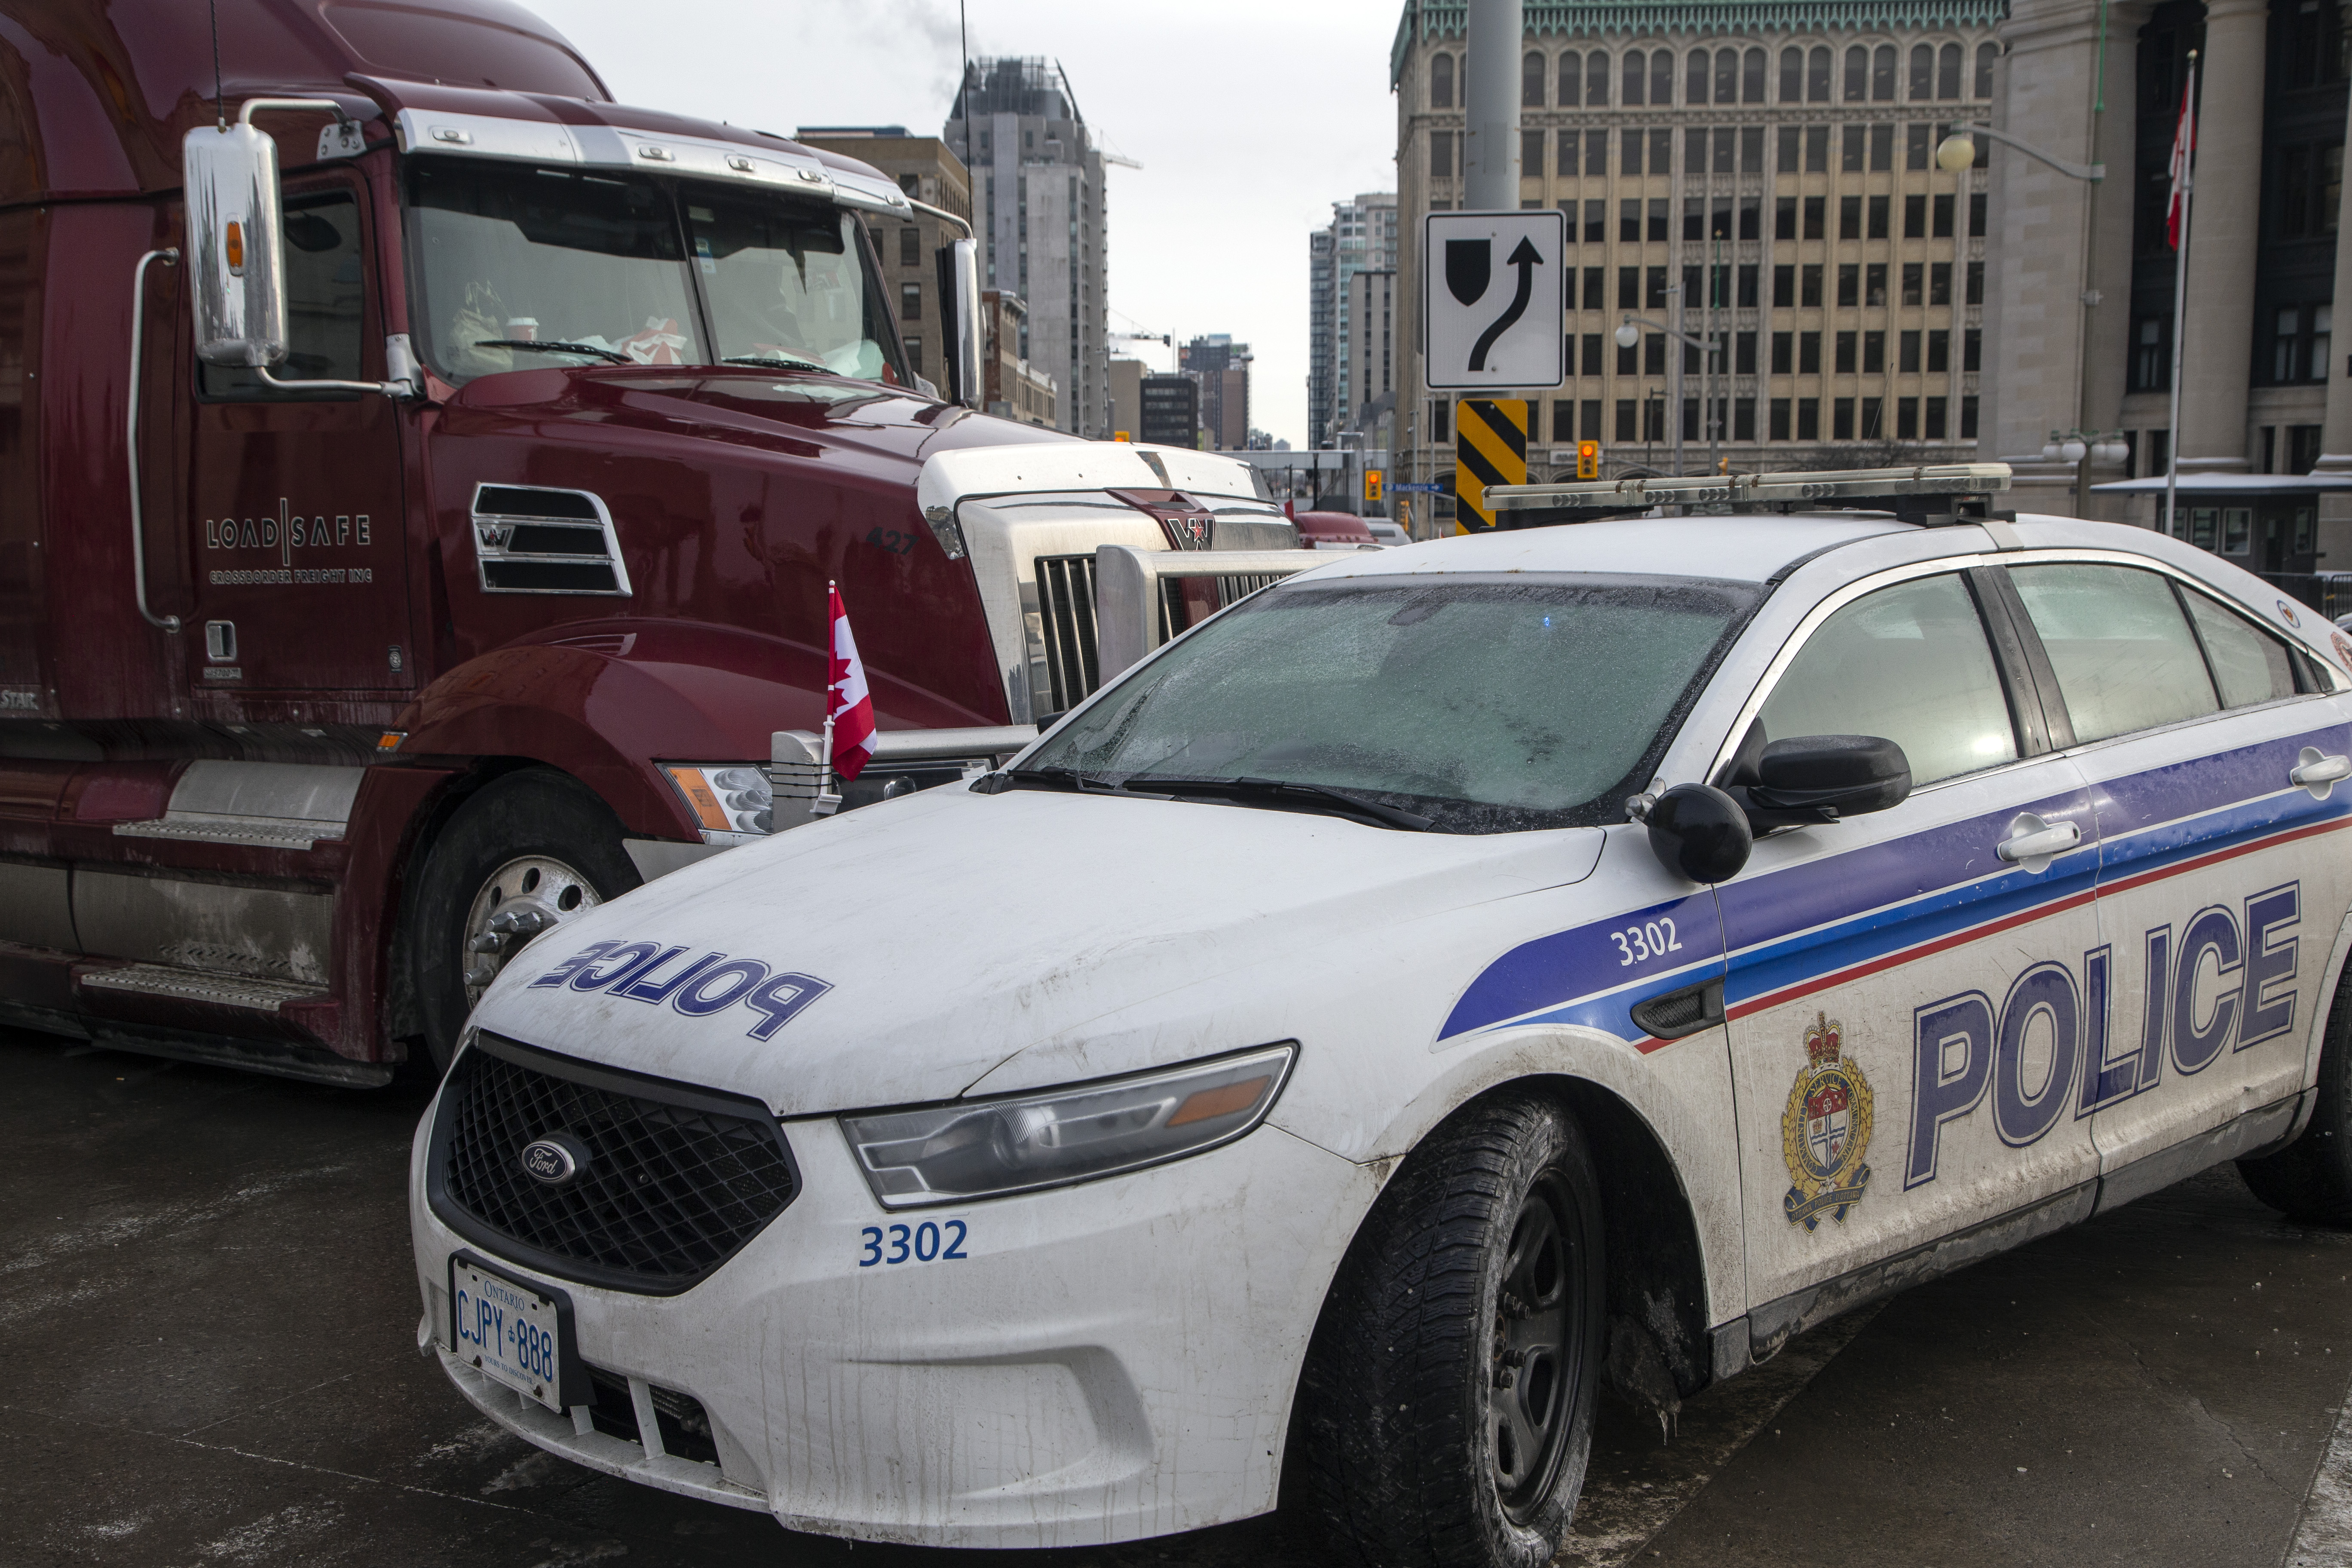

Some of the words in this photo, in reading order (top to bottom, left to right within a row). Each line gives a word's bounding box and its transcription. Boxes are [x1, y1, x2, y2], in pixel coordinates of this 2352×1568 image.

[866, 527, 920, 555] 427
[209, 570, 293, 585] CROSSBORDER
[294, 569, 345, 583] FREIGHT
[349, 568, 373, 583] INC
[0, 689, 39, 710] STAR
[1611, 917, 1682, 966] 3302
[1904, 879, 2300, 1192] POLICE
[1810, 1073, 1843, 1095] SERVICE
[1798, 1100, 1818, 1174] COMMUNITY
[530, 1148, 558, 1175] Ford
[1792, 1204, 1812, 1221] OTTAWA
[1814, 1194, 1833, 1208] POLICE
[1835, 1190, 1860, 1201] D'OTTAWA
[860, 1219, 968, 1267] 3302
[484, 1280, 525, 1311] ONTARIO
[458, 1289, 503, 1357] CJPY
[517, 1318, 553, 1382] 888
[484, 1354, 500, 1368] YOURS
[501, 1363, 508, 1372] TO
[509, 1367, 533, 1384] DISCOVER
